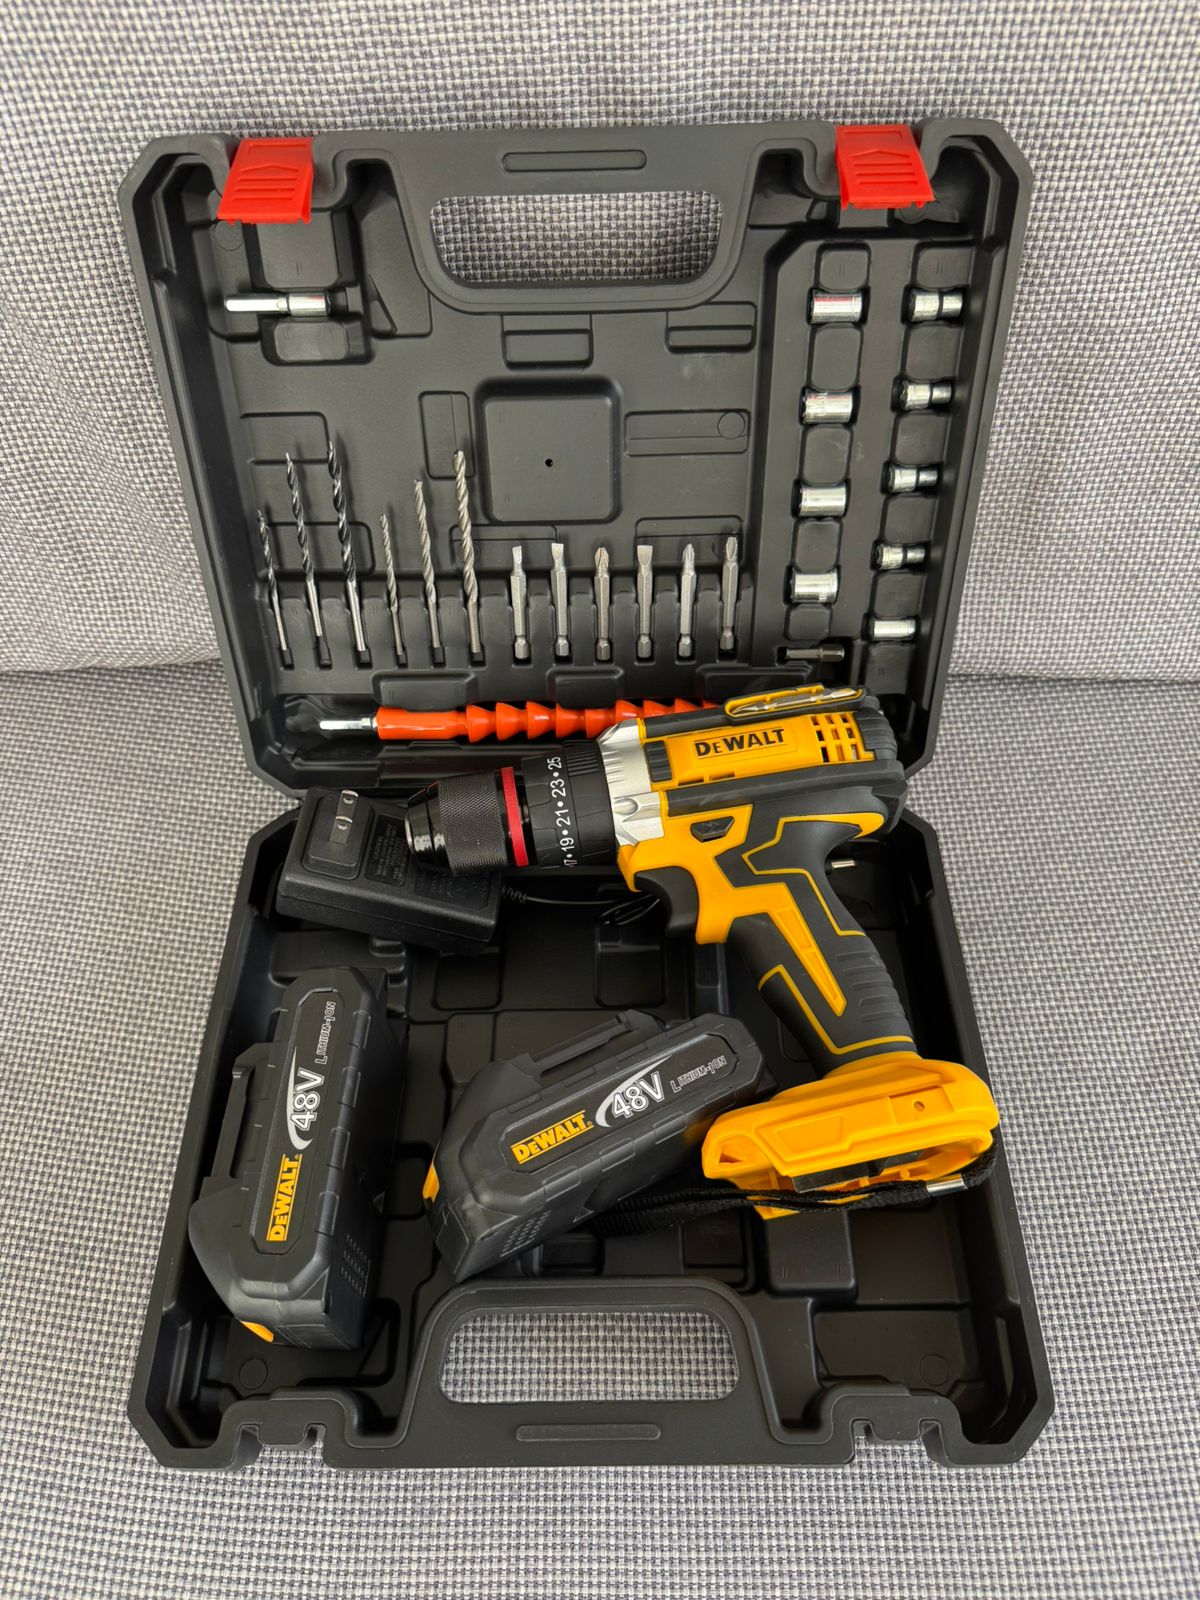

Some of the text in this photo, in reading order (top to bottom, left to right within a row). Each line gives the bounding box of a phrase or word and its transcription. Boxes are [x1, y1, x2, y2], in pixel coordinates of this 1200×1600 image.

[547, 756, 562, 770] 25
[550, 778, 567, 798] 23
[554, 809, 571, 827] 21
[560, 837, 575, 852] 19
[290, 1066, 325, 1131] 48V
[315, 1001, 337, 1064] LITHIUM-ION
[611, 1071, 665, 1119] 48V
[669, 1055, 728, 1093] LITHIUM-ION
